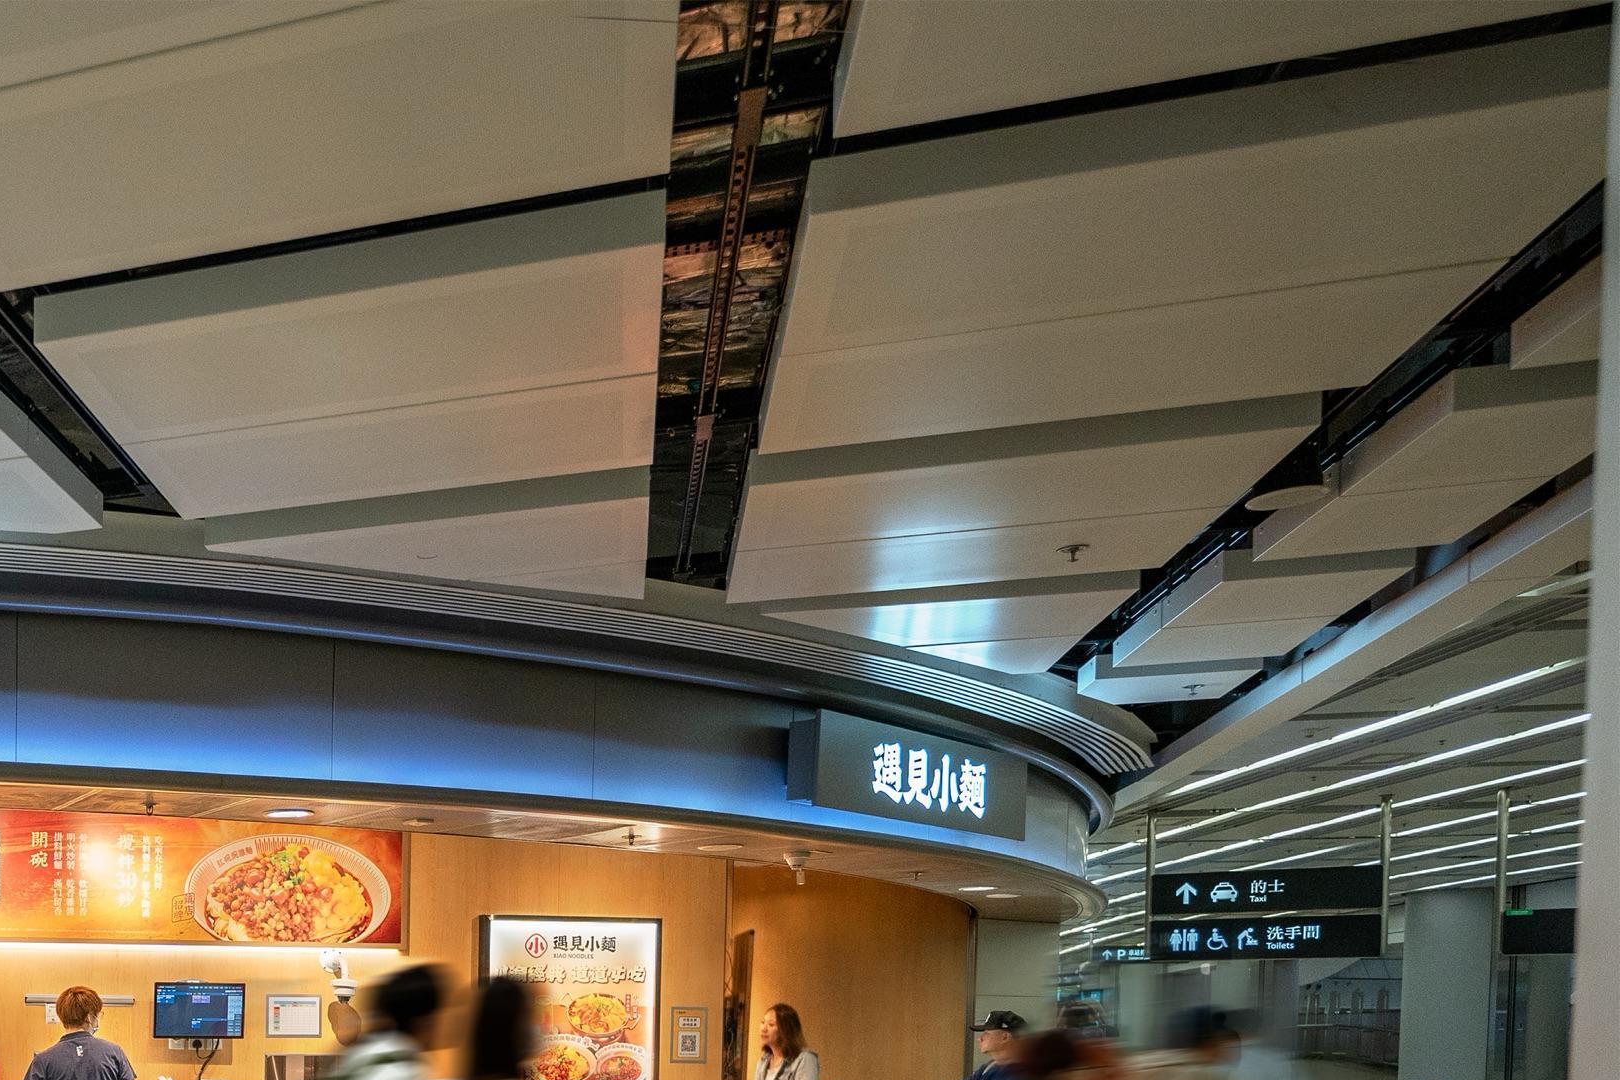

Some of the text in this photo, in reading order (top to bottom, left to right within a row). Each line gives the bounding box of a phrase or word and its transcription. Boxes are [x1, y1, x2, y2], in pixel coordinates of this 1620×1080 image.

[872, 742, 986, 819] 遇見小麵
[28, 831, 49, 868] 開碗
[1250, 879, 1285, 894] 的士
[1249, 895, 1267, 903] Taxi
[1266, 925, 1320, 940] 洗手間
[553, 935, 616, 953] 遇見小麵
[1266, 942, 1295, 950] Toilets
